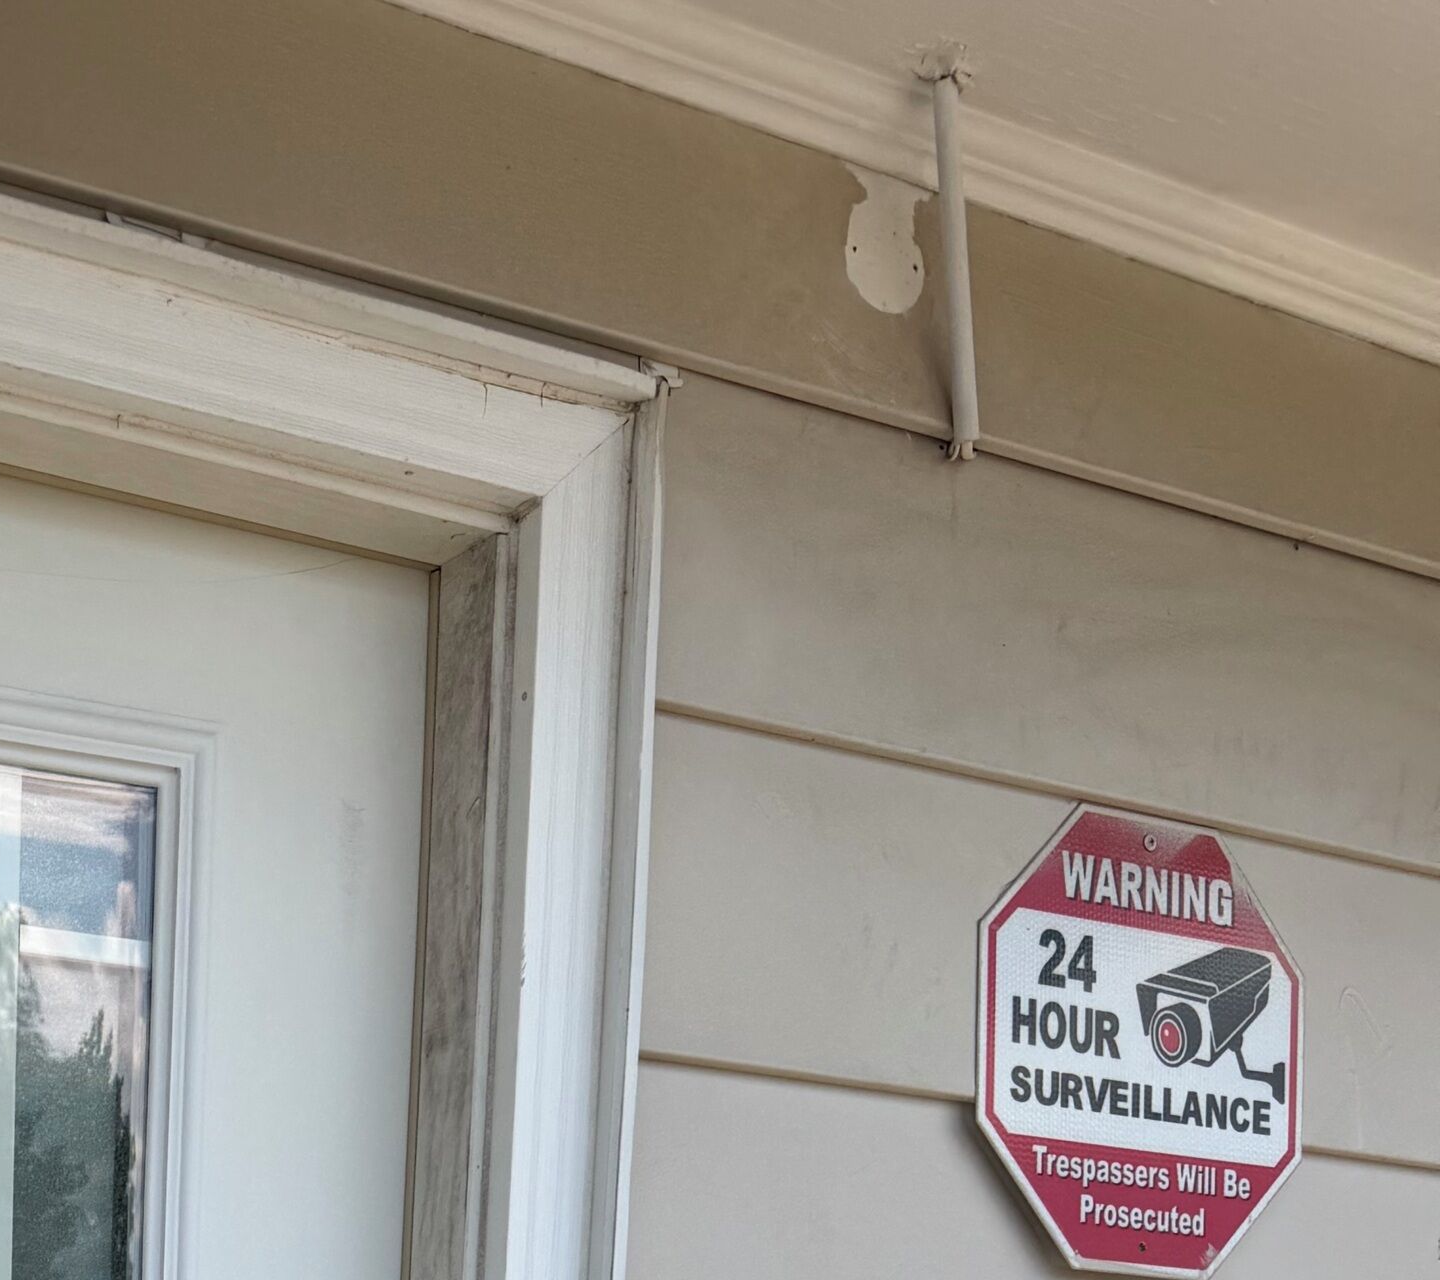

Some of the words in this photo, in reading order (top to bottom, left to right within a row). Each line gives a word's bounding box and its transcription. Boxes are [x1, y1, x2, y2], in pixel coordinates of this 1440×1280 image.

[1062, 850, 1234, 927] WARNING
[1037, 928, 1097, 993] 24
[1011, 995, 1121, 1060] HOUR
[1009, 1065, 1272, 1136] SURVEILLANCE
[1032, 1144, 1170, 1190] Trespassers
[1176, 1162, 1216, 1196] Will
[1223, 1168, 1251, 1200] Be
[1079, 1194, 1205, 1237] Prosecuted
